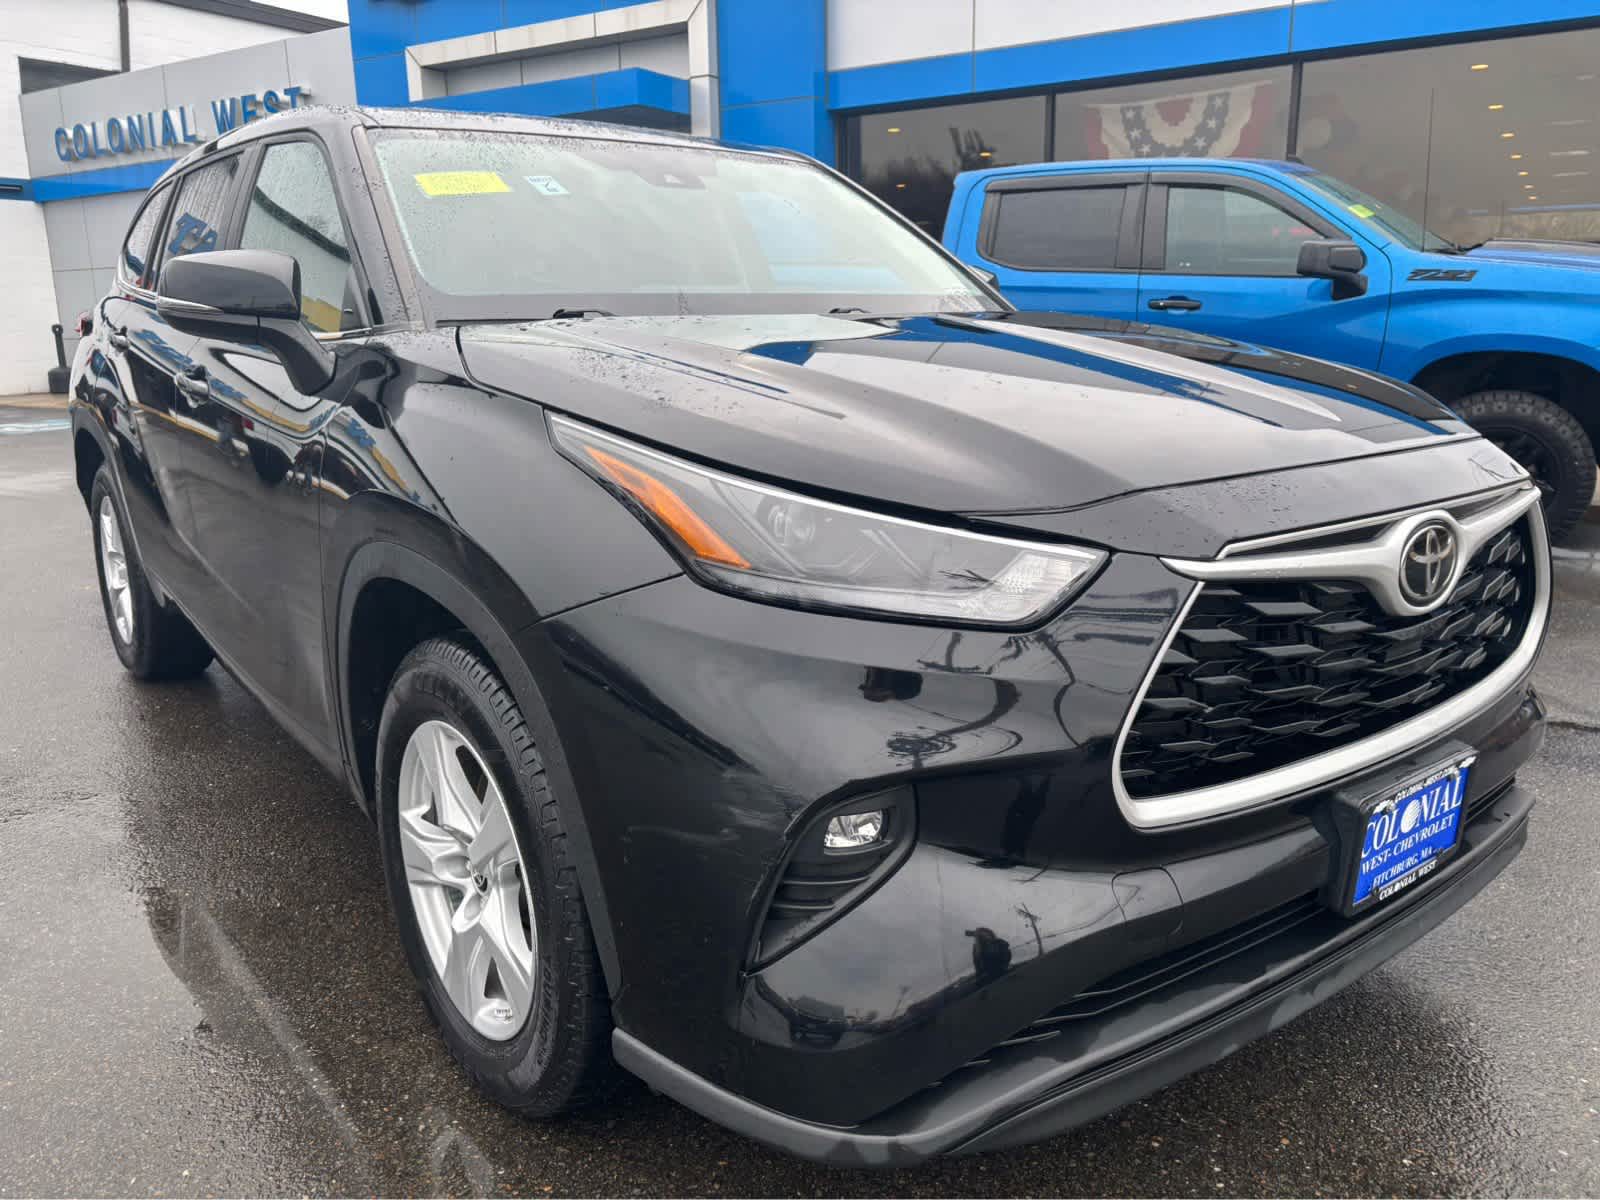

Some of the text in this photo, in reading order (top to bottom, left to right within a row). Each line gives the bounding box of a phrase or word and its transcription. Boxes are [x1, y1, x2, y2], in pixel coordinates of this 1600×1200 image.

[54, 86, 302, 162] COLONIAL WEST
[1361, 775, 1463, 858] COLONIAL
[1379, 860, 1438, 900] COLONIAL WEST
